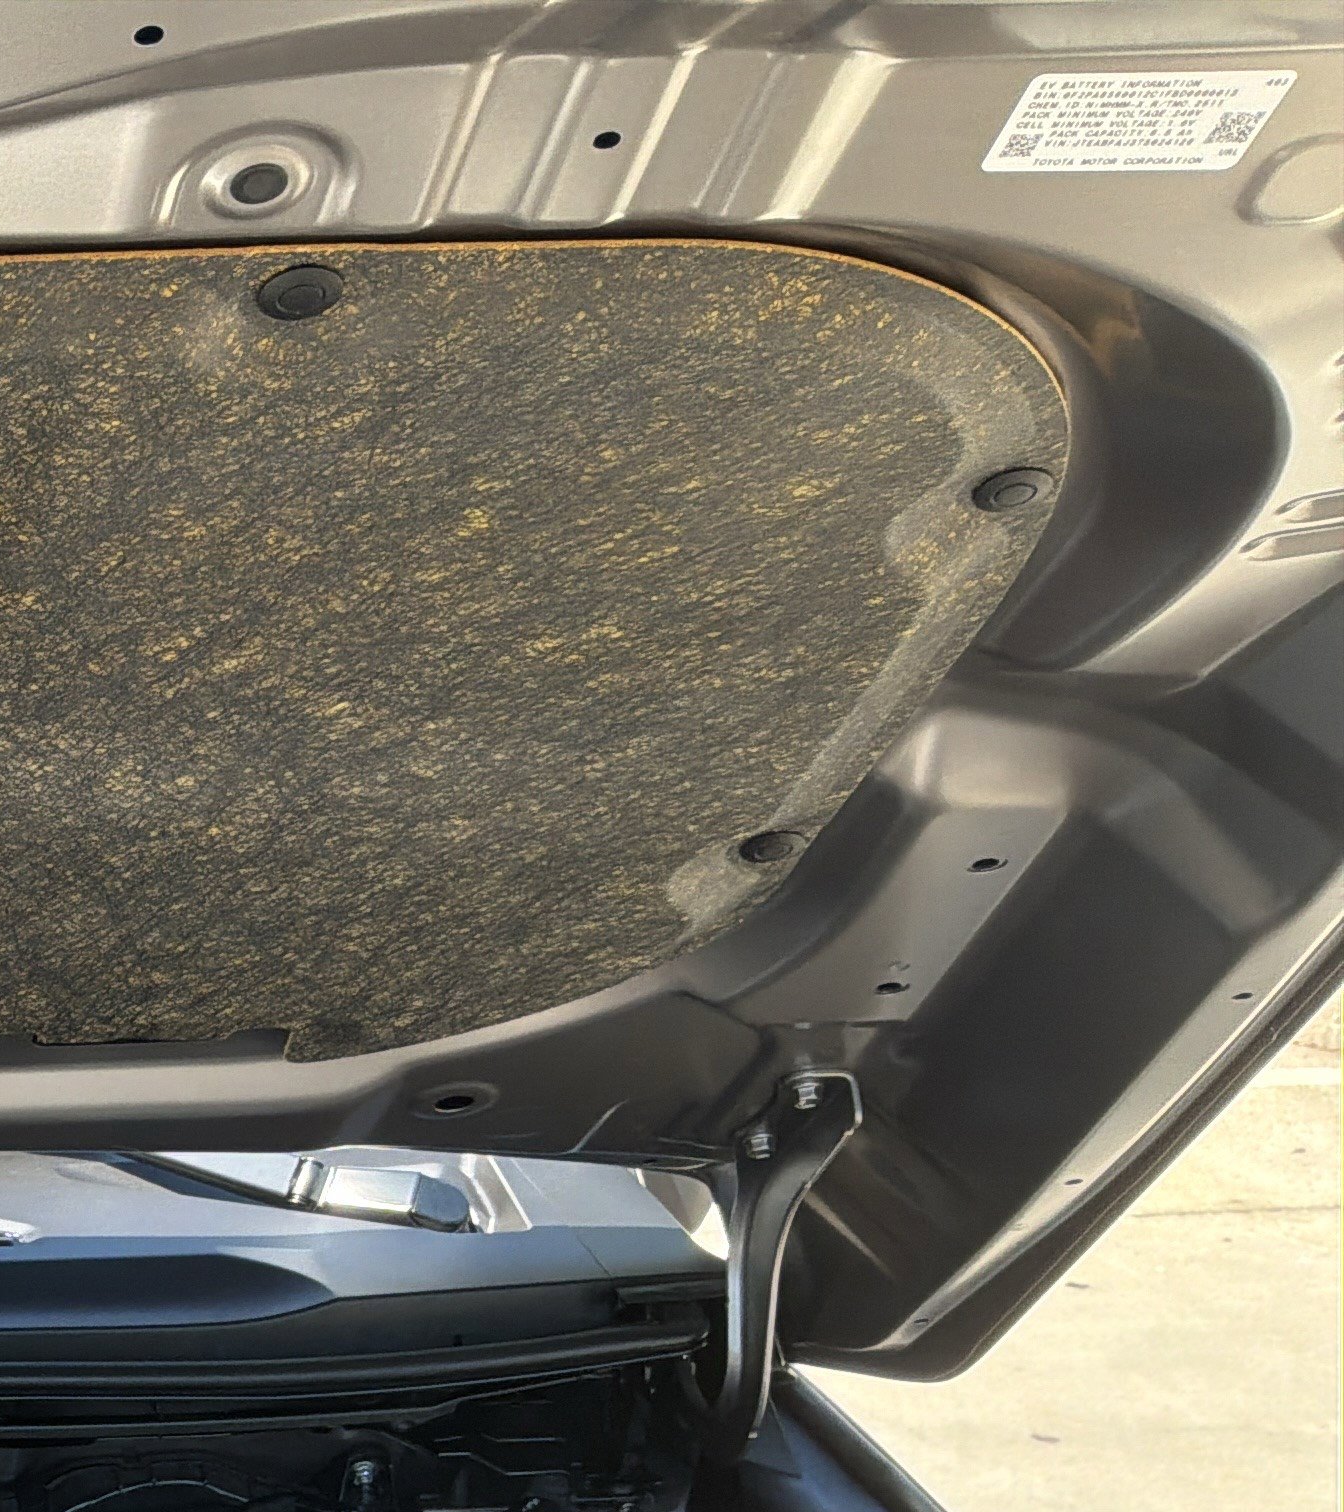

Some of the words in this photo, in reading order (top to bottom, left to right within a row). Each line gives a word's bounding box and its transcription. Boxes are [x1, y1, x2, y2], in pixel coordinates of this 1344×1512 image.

[1032, 157, 1076, 167] TOYOTA
[1080, 157, 1120, 166] MOTOR
[1122, 156, 1204, 166] CORPORATION
